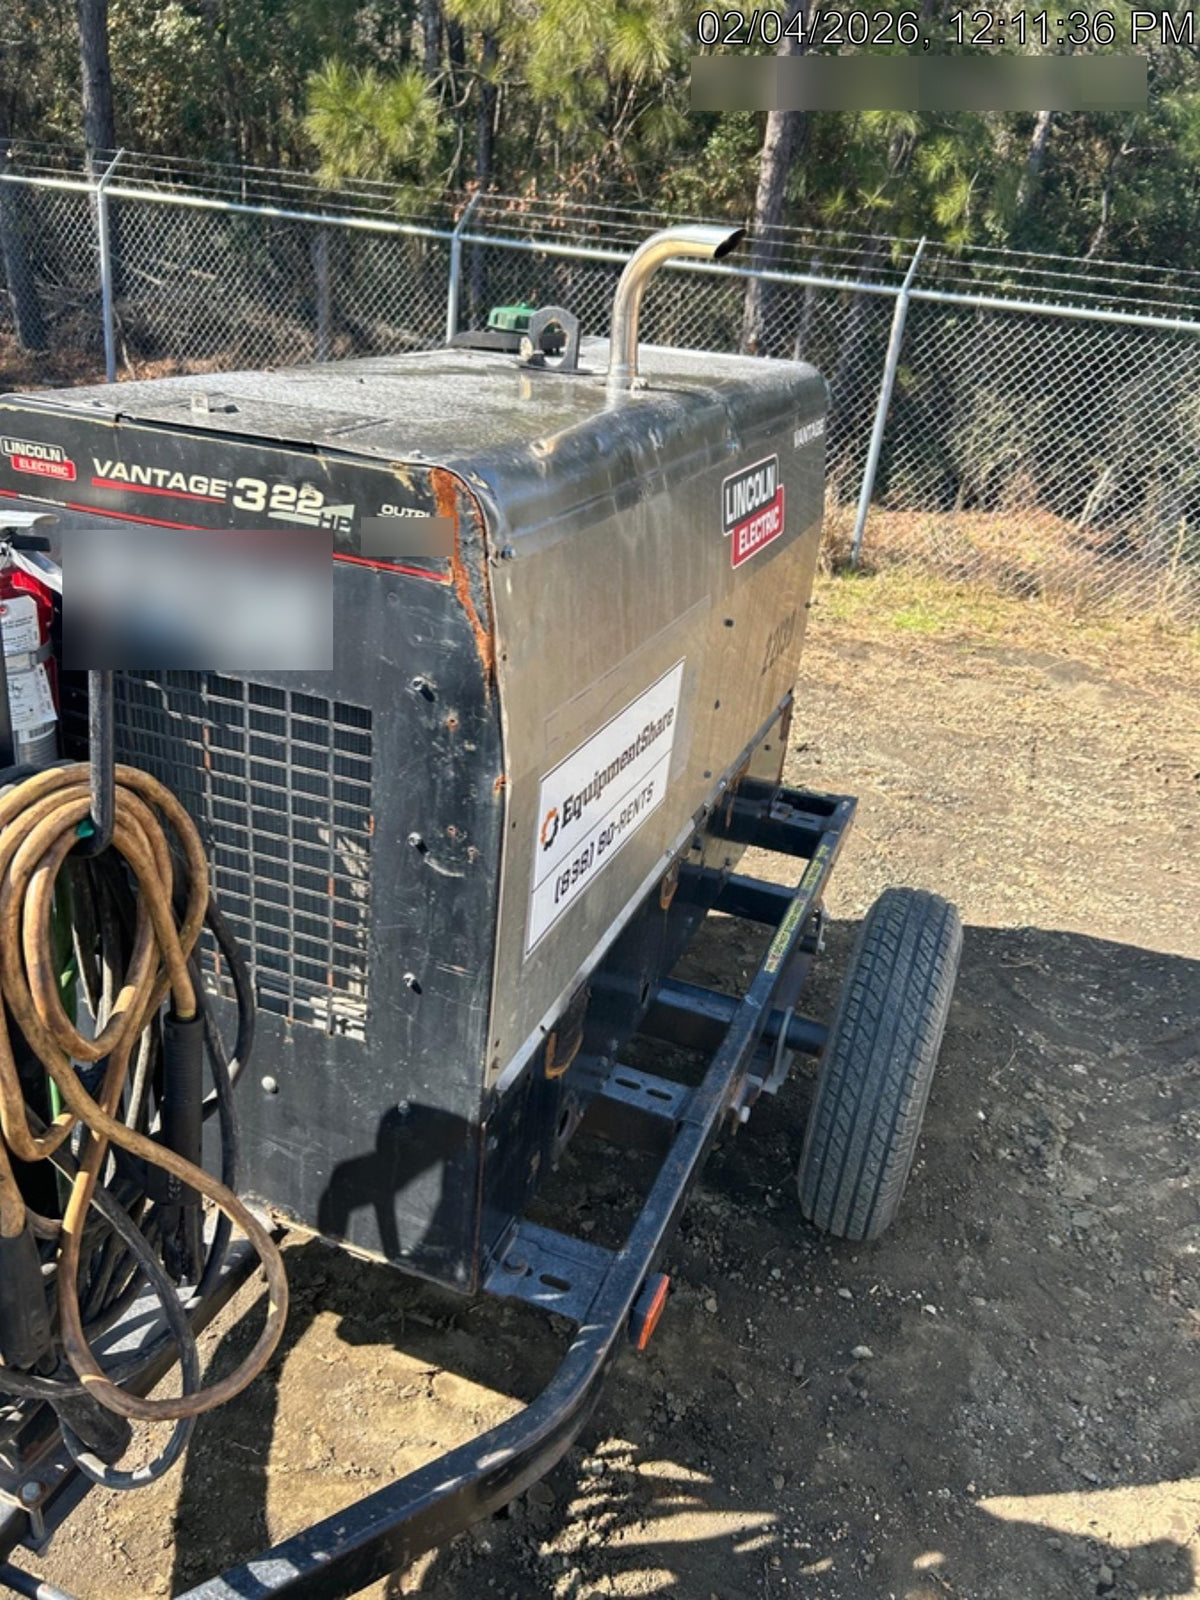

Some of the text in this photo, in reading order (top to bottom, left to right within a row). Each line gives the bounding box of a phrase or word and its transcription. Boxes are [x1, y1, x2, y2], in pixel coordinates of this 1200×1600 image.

[3, 440, 62, 463] LINCOLN
[18, 459, 69, 477] ELECTRIC
[92, 457, 228, 499] VANTAGE
[725, 463, 776, 526] LINCOLN
[738, 505, 780, 556] ELECTRIC
[561, 707, 675, 829] EquipmentShare
